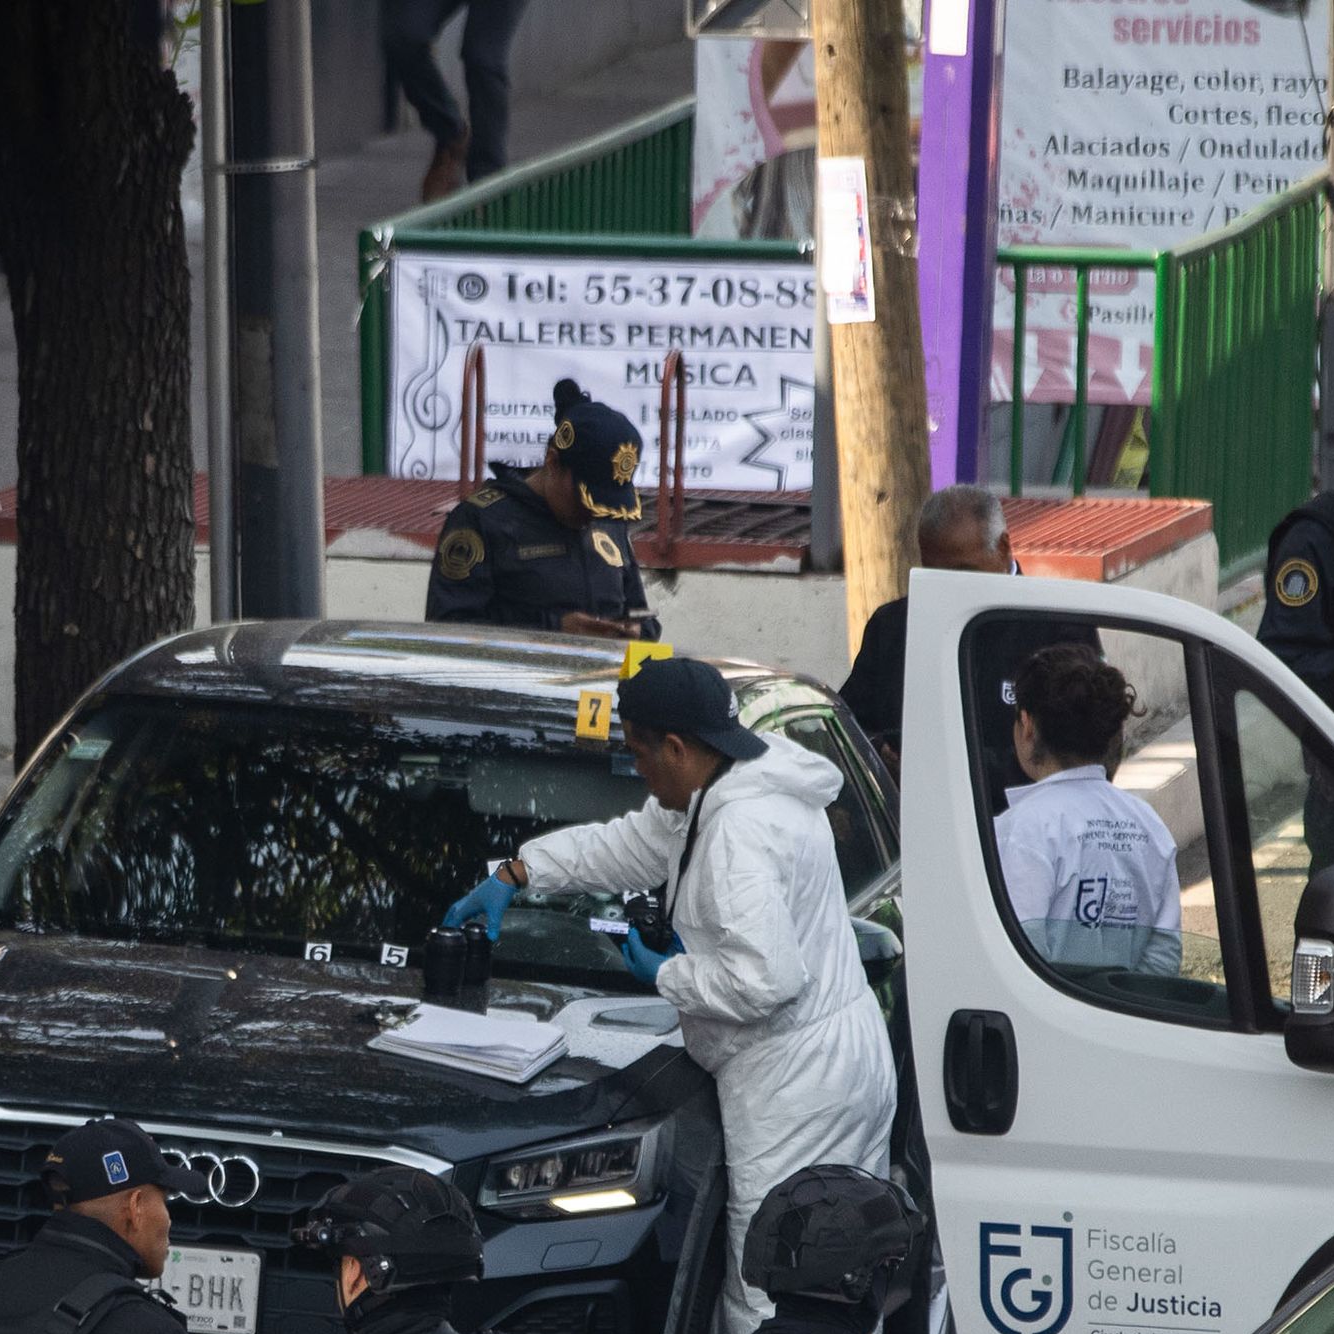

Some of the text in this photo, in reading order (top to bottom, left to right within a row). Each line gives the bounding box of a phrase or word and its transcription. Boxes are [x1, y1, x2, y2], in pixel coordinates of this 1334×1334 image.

[1113, 15, 1260, 45] servicios
[1063, 68, 1185, 95] Balayage,
[1193, 72, 1265, 94] color,
[1168, 104, 1259, 128] Cortes,
[1043, 135, 1170, 157] Alaciados
[1068, 169, 1205, 195] Maquillaje
[1234, 174, 1298, 195] Pein
[1071, 205, 1195, 228] Manicure
[507, 273, 567, 302] Tel:
[454, 319, 812, 349] TALLERES PERMANEN
[487, 431, 552, 444] UKULE
[588, 698, 602, 728] 7
[309, 944, 329, 961] 6
[385, 947, 405, 966] 5
[1088, 1229, 1176, 1254] Fiscalía
[1088, 1259, 1183, 1285] General
[157, 1270, 245, 1312] -BHK
[1088, 1291, 1222, 1318] de Justicia
